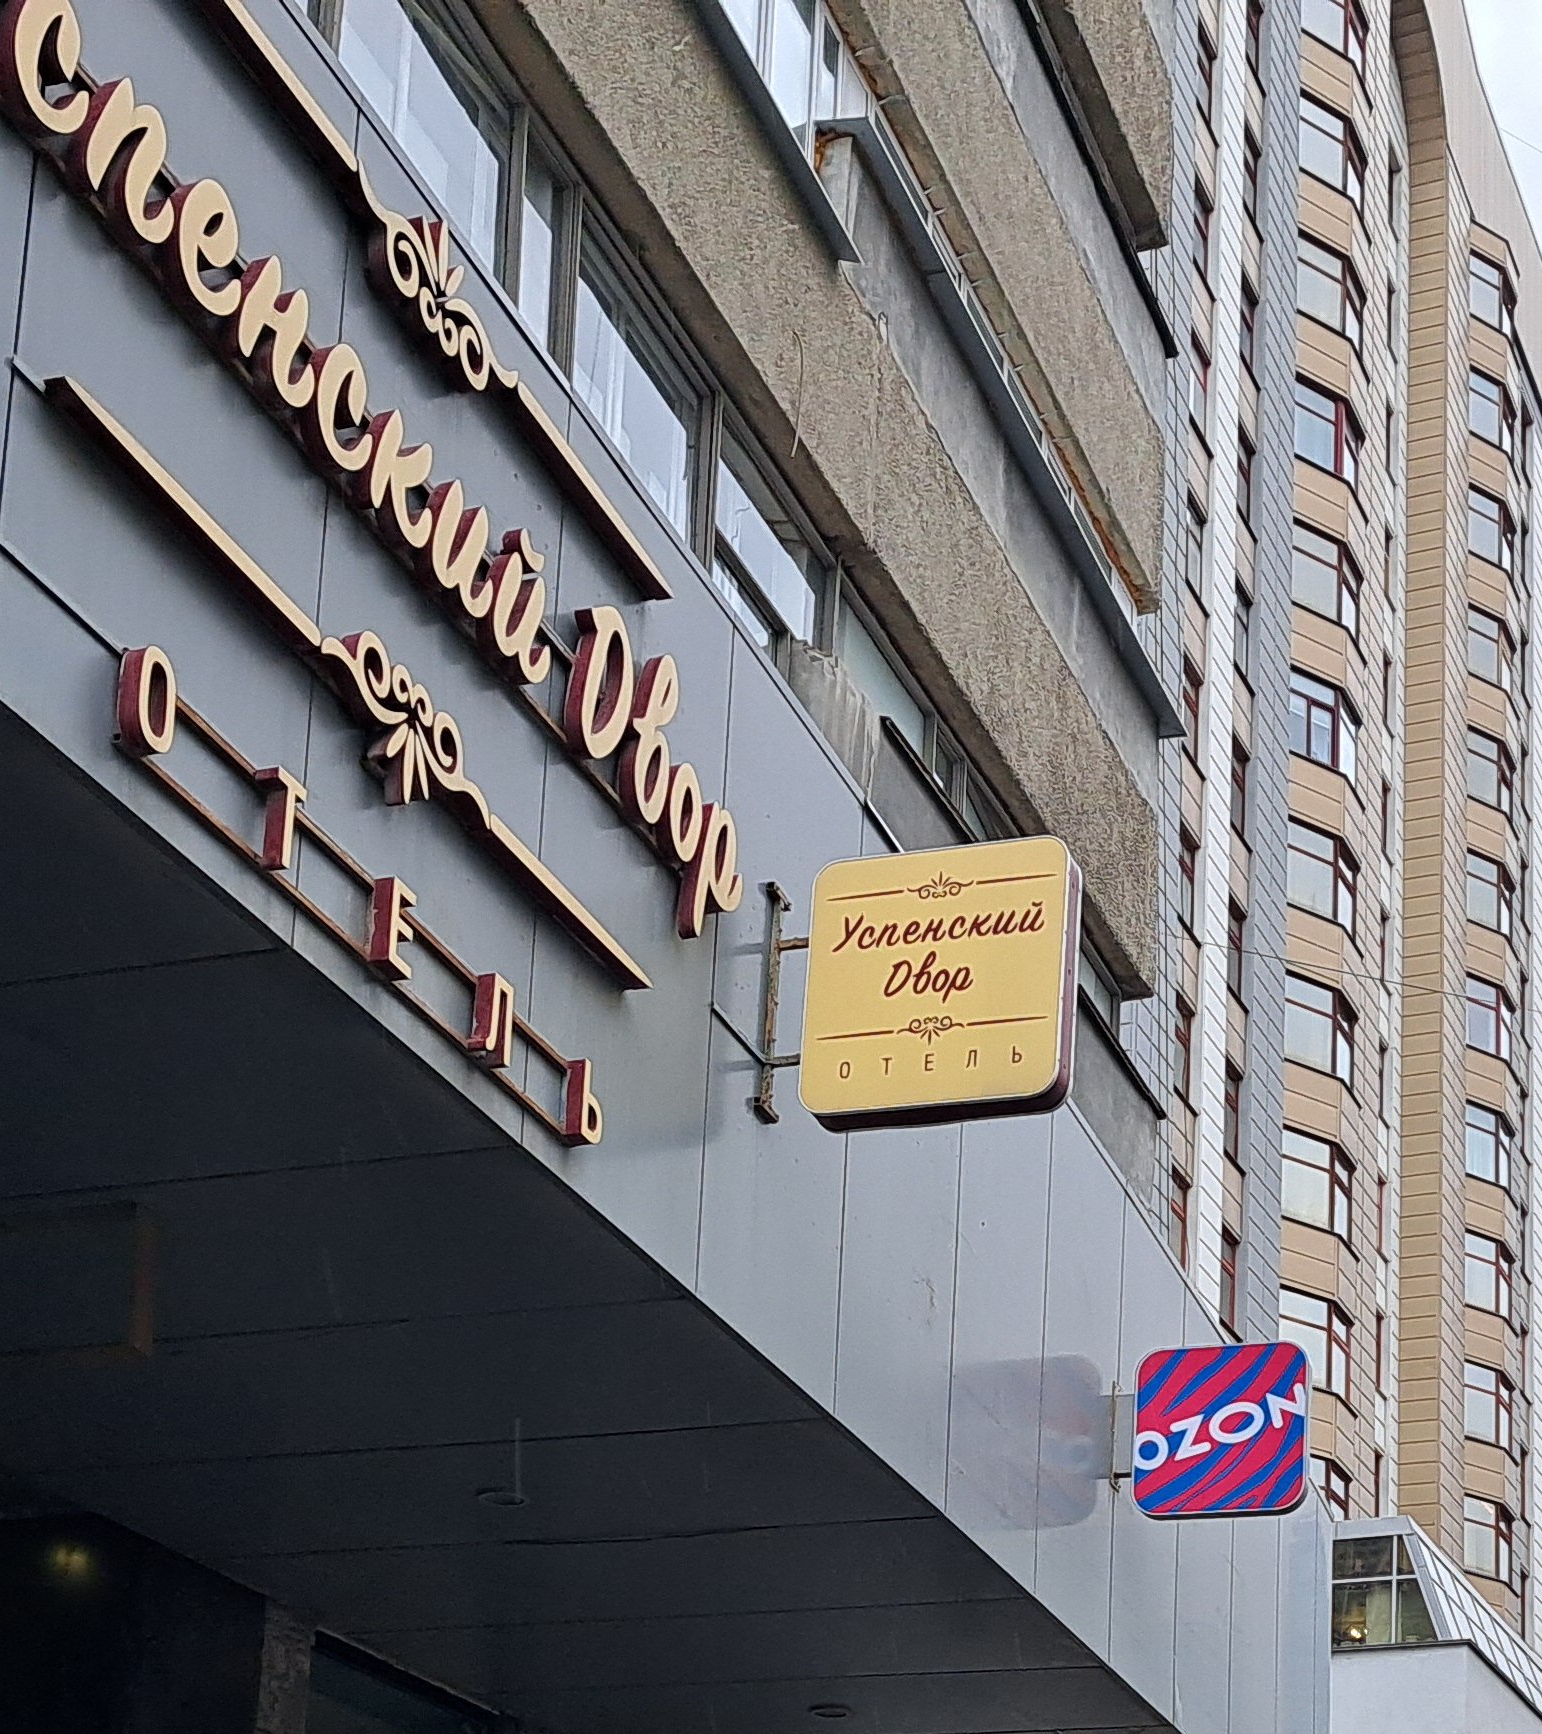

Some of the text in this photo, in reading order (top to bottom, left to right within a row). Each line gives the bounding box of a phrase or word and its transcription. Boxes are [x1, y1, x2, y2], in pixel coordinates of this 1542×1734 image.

[565, 605, 743, 939] Двор
[114, 644, 603, 1147] ОТЕЛЬ
[831, 901, 1046, 953] Успенский
[883, 951, 974, 1003] Двор
[838, 1046, 1024, 1081] ОТЕЛЬ
